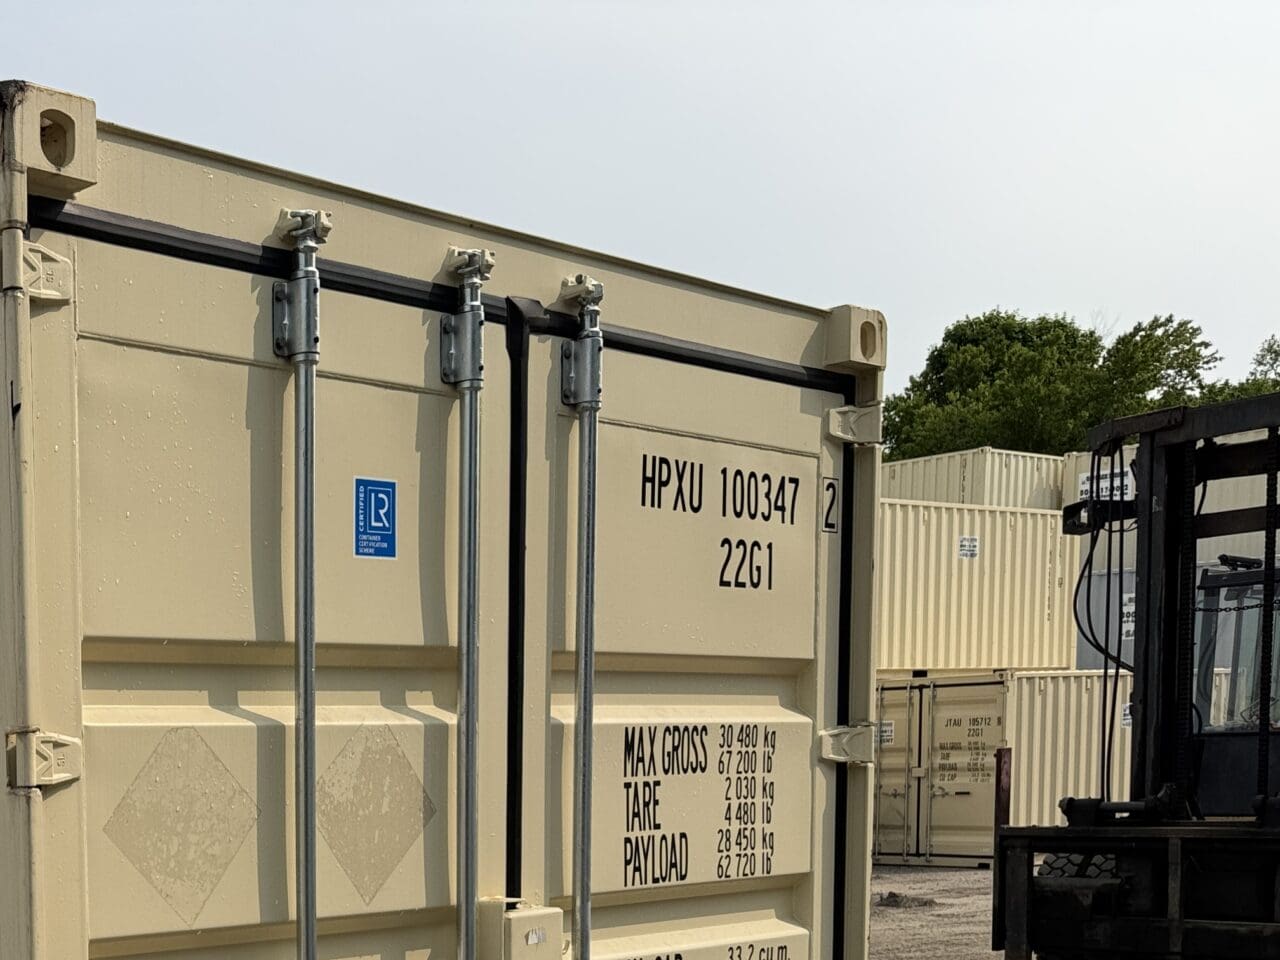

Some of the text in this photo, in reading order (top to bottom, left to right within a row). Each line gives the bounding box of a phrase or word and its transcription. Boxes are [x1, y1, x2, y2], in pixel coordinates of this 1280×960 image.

[358, 485, 366, 532] CERTIFIED
[371, 493, 390, 528] LR
[641, 454, 837, 530] HPXU 100347 2
[718, 537, 774, 591] 22G1
[623, 724, 777, 778] MAX GROSS 30 480 kg
[718, 750, 773, 775] 67 200 lb
[623, 776, 775, 833] TARE 2 030 kg
[724, 801, 772, 827] 4 480 lb
[623, 827, 775, 888] PAYLOAD 28 450 kg
[717, 852, 772, 880] 62 720 lb
